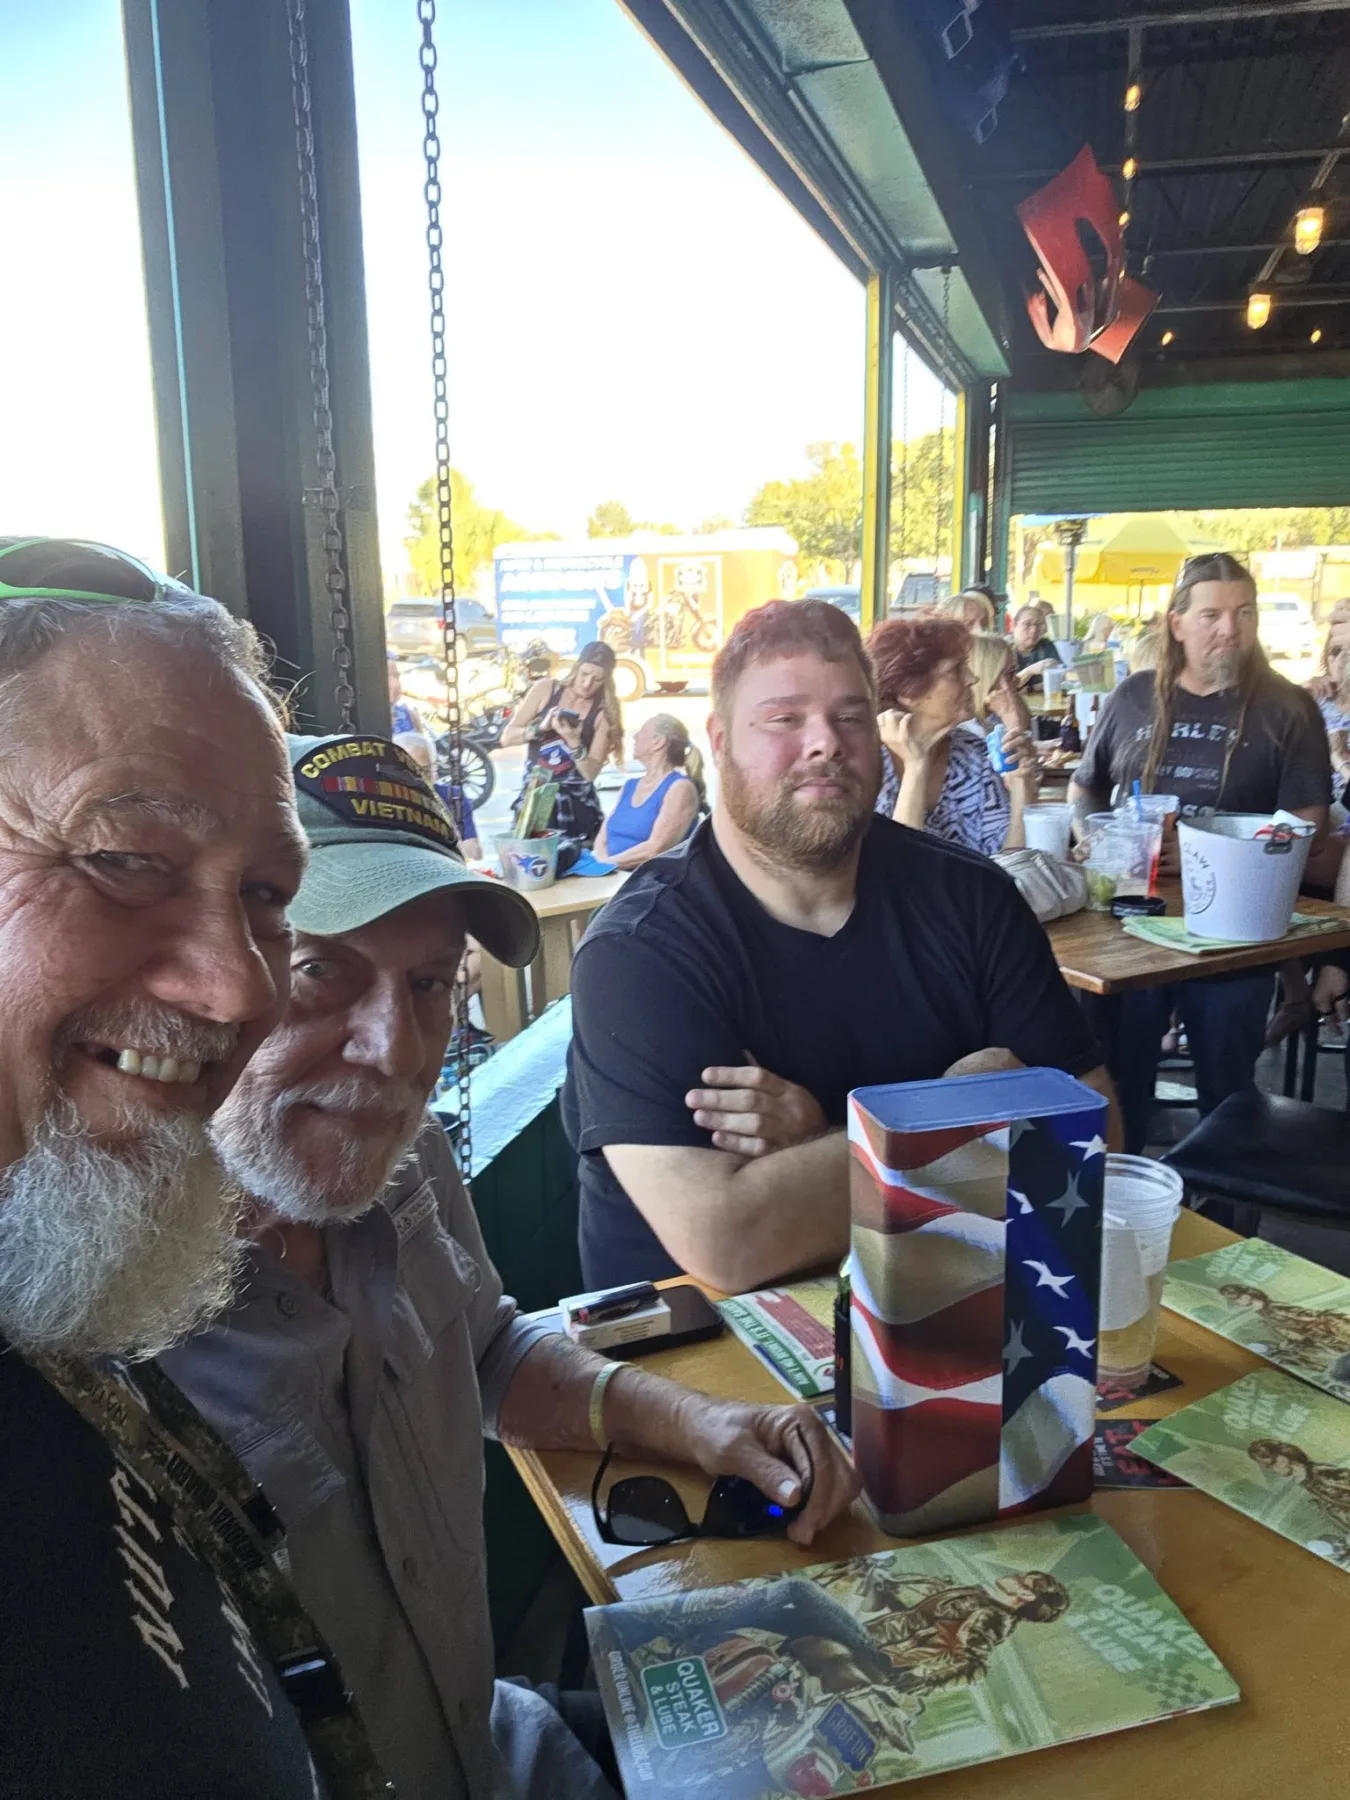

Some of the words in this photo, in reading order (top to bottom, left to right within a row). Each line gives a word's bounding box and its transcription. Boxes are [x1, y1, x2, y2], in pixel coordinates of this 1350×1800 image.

[301, 742, 387, 779] COMBAT
[351, 798, 449, 838] VIETNAM
[652, 1697, 677, 1736] LUBE
[666, 1682, 697, 1734] STEAK
[676, 1662, 720, 1737] QUAKER
